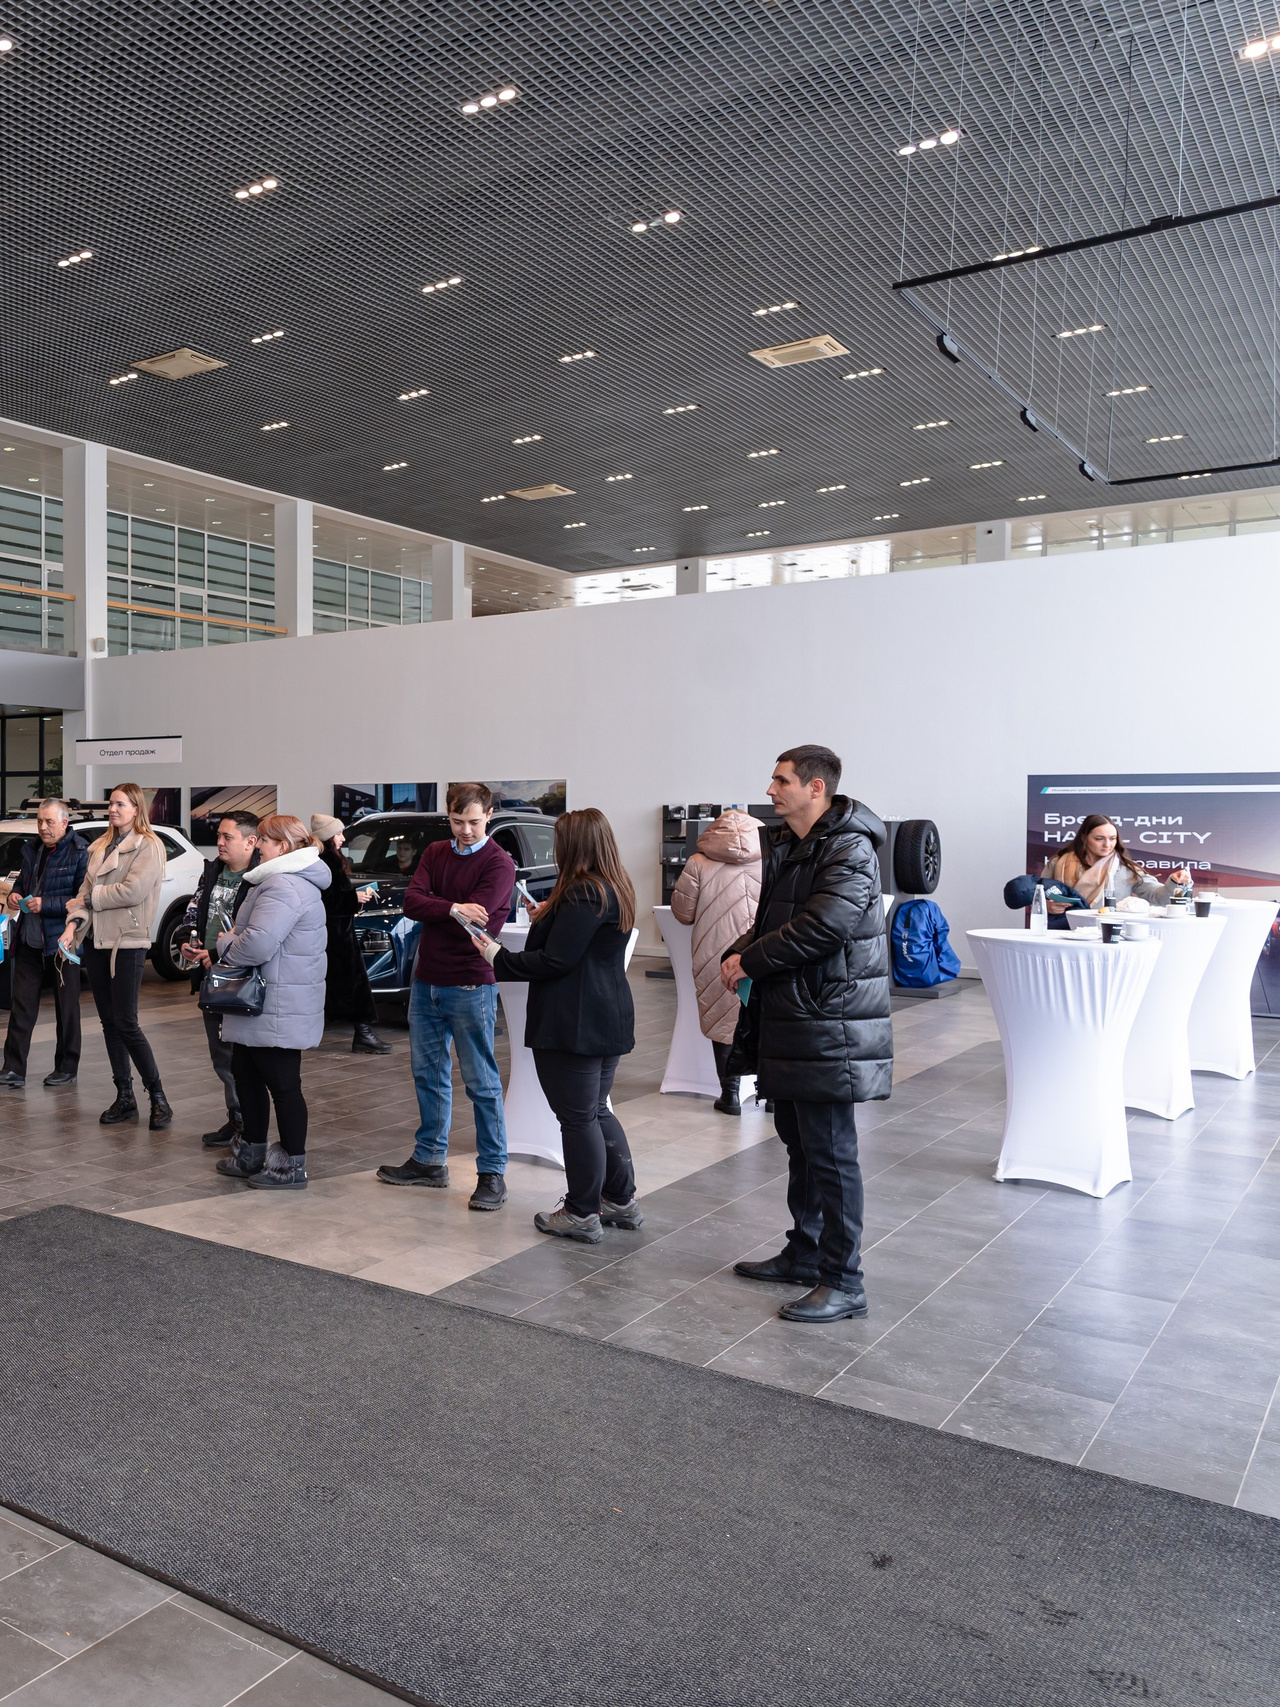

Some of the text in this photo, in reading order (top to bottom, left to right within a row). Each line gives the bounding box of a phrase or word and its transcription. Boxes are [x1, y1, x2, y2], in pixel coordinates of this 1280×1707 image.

[99, 748, 156, 757] Отдел продаж
[1044, 813, 1183, 827] Бред-дни
[1139, 831, 1212, 844] CITY
